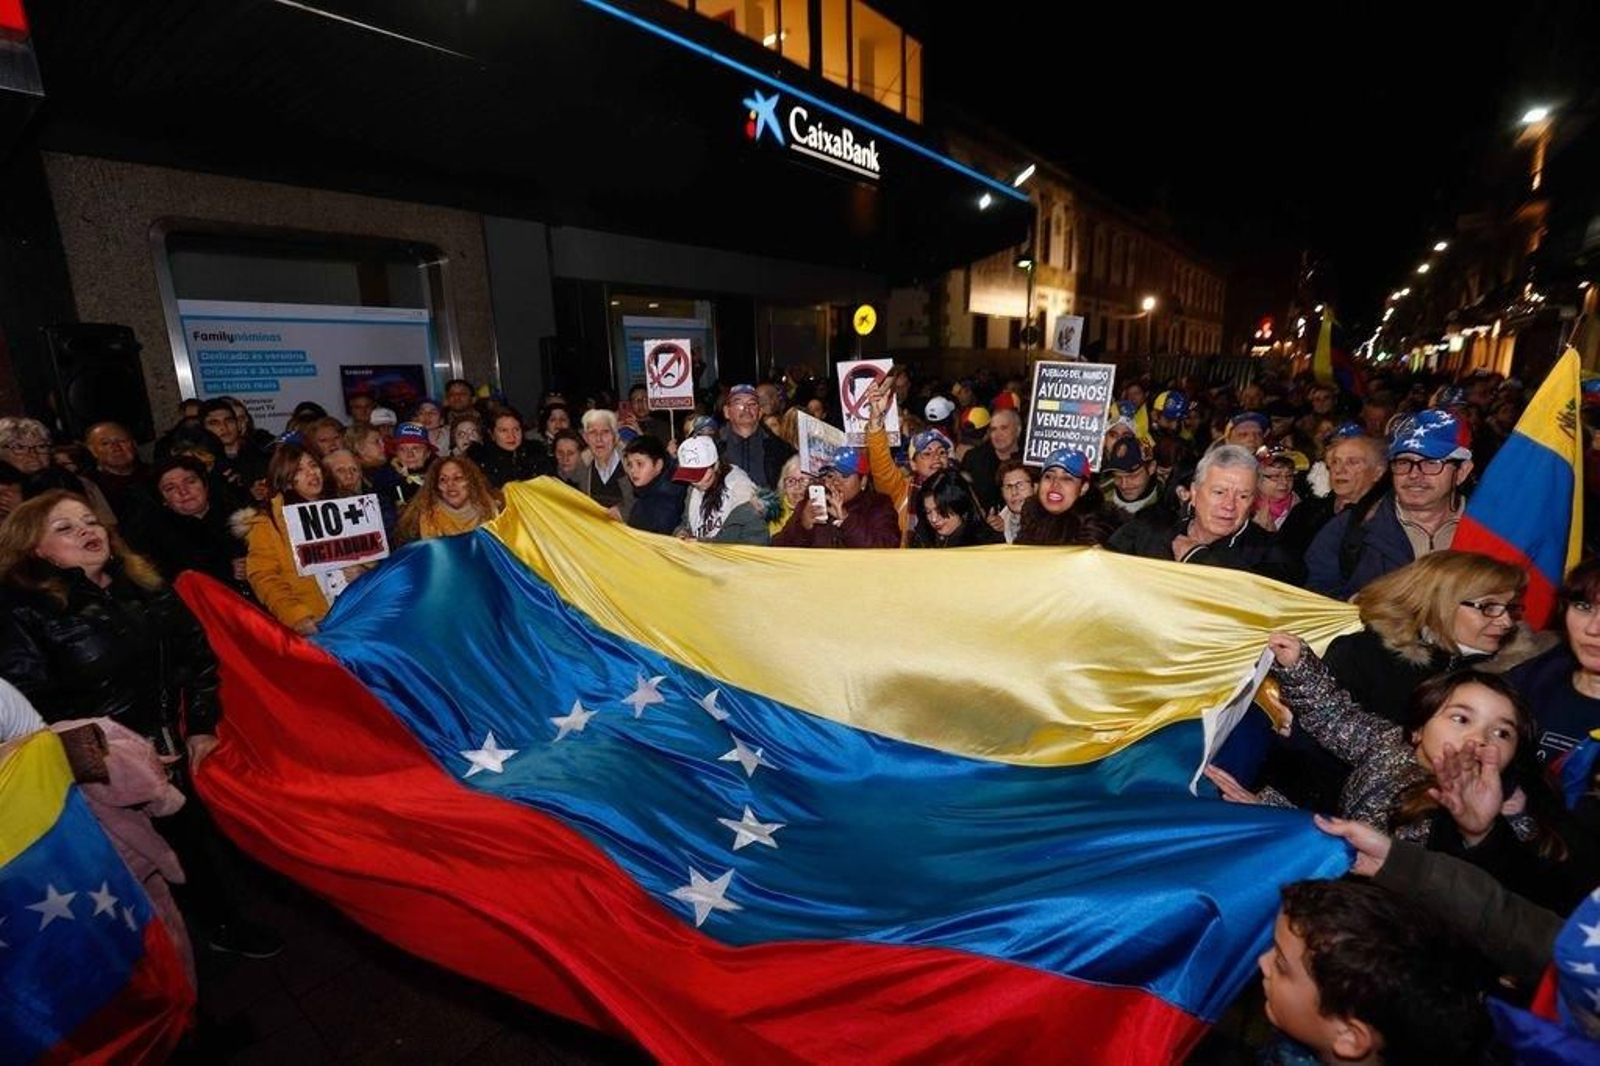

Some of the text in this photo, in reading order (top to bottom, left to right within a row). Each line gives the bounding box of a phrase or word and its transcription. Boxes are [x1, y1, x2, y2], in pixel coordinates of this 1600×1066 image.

[789, 106, 880, 172] CaixaBank
[1041, 368, 1109, 381] PUEBLOS DEL MUNDO
[1038, 379, 1107, 401] AYÚDENOS!
[1044, 429, 1081, 441] LUCHANDO
